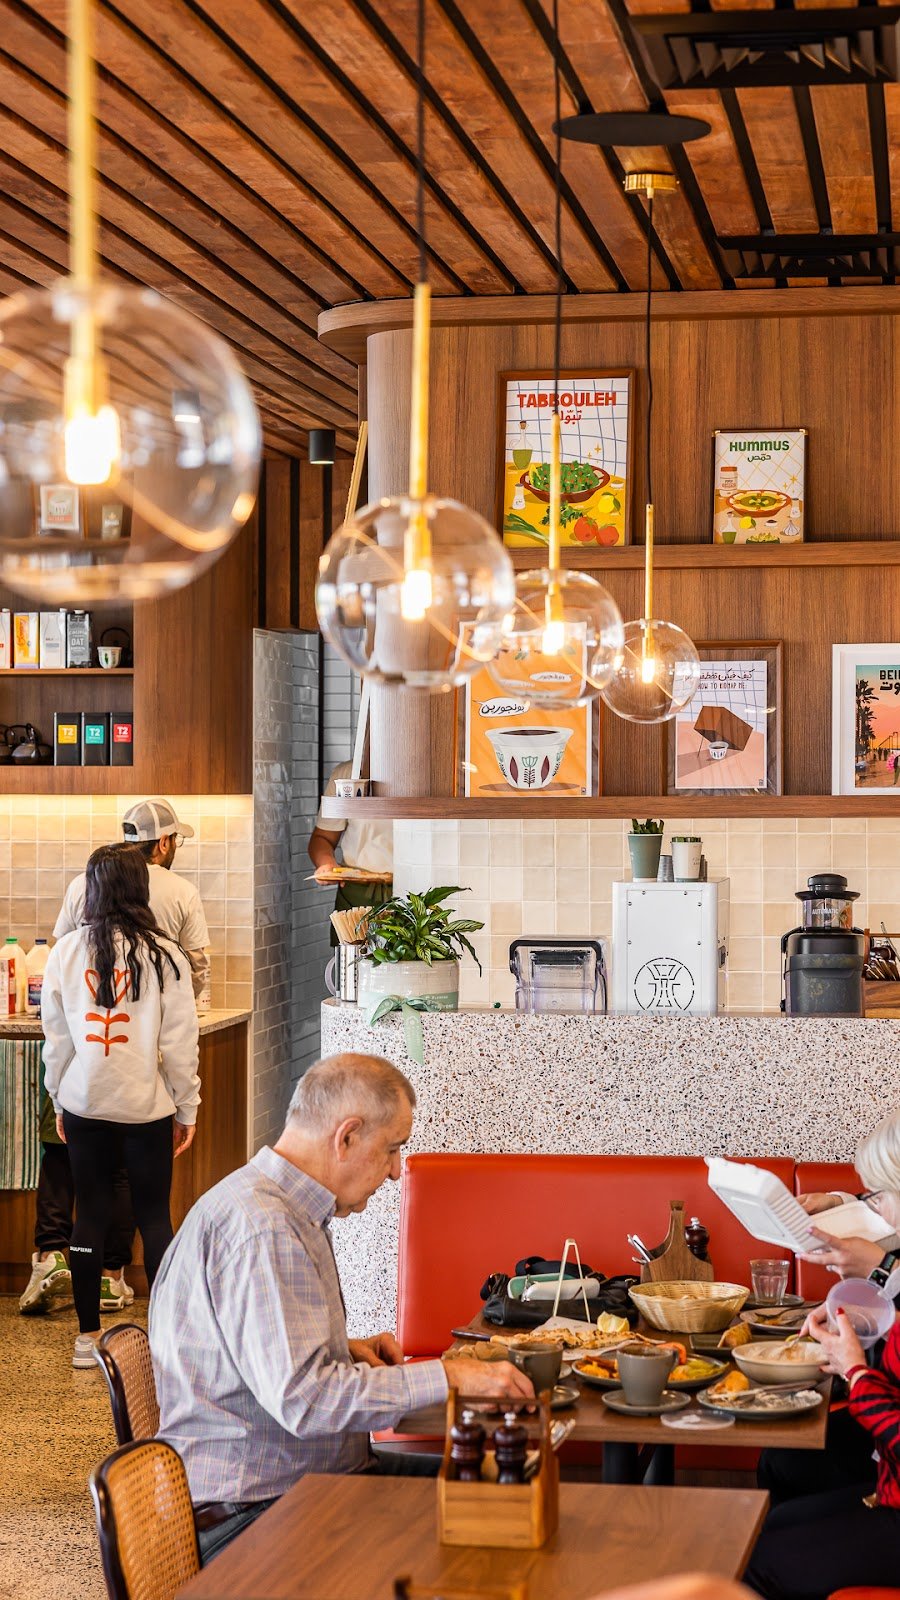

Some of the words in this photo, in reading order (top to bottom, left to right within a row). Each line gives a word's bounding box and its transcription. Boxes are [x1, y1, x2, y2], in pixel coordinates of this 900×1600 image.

[517, 391, 617, 408] TABBOULEH
[729, 440, 790, 452] HUMMUS
[71, 638, 84, 646] OAT
[880, 670, 900, 680] BEI
[63, 727, 74, 736] T2
[89, 728, 101, 737] T2
[117, 726, 129, 735] T2
